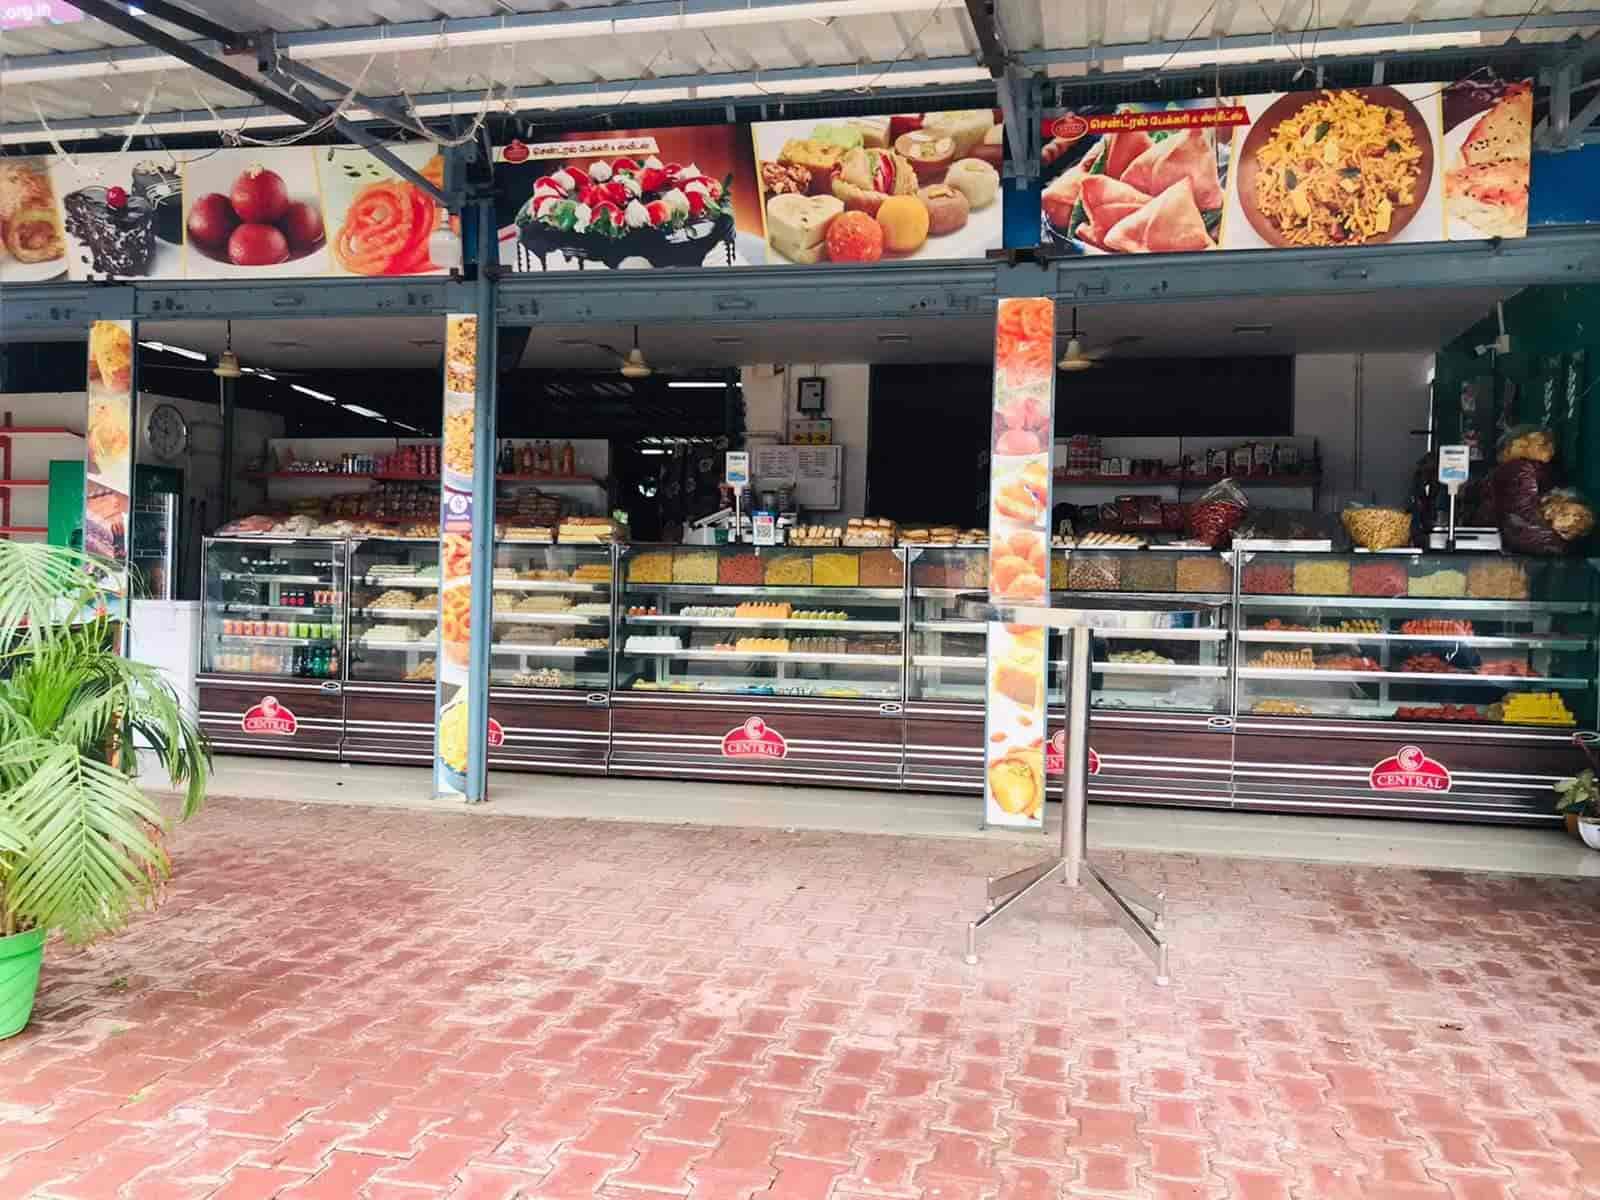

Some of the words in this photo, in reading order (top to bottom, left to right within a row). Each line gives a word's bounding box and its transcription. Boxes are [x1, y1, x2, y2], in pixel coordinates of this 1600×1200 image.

[247, 719, 291, 731] CENTRAL
[727, 743, 780, 755] CENTRAL
[1377, 775, 1442, 788] CENTRAL
